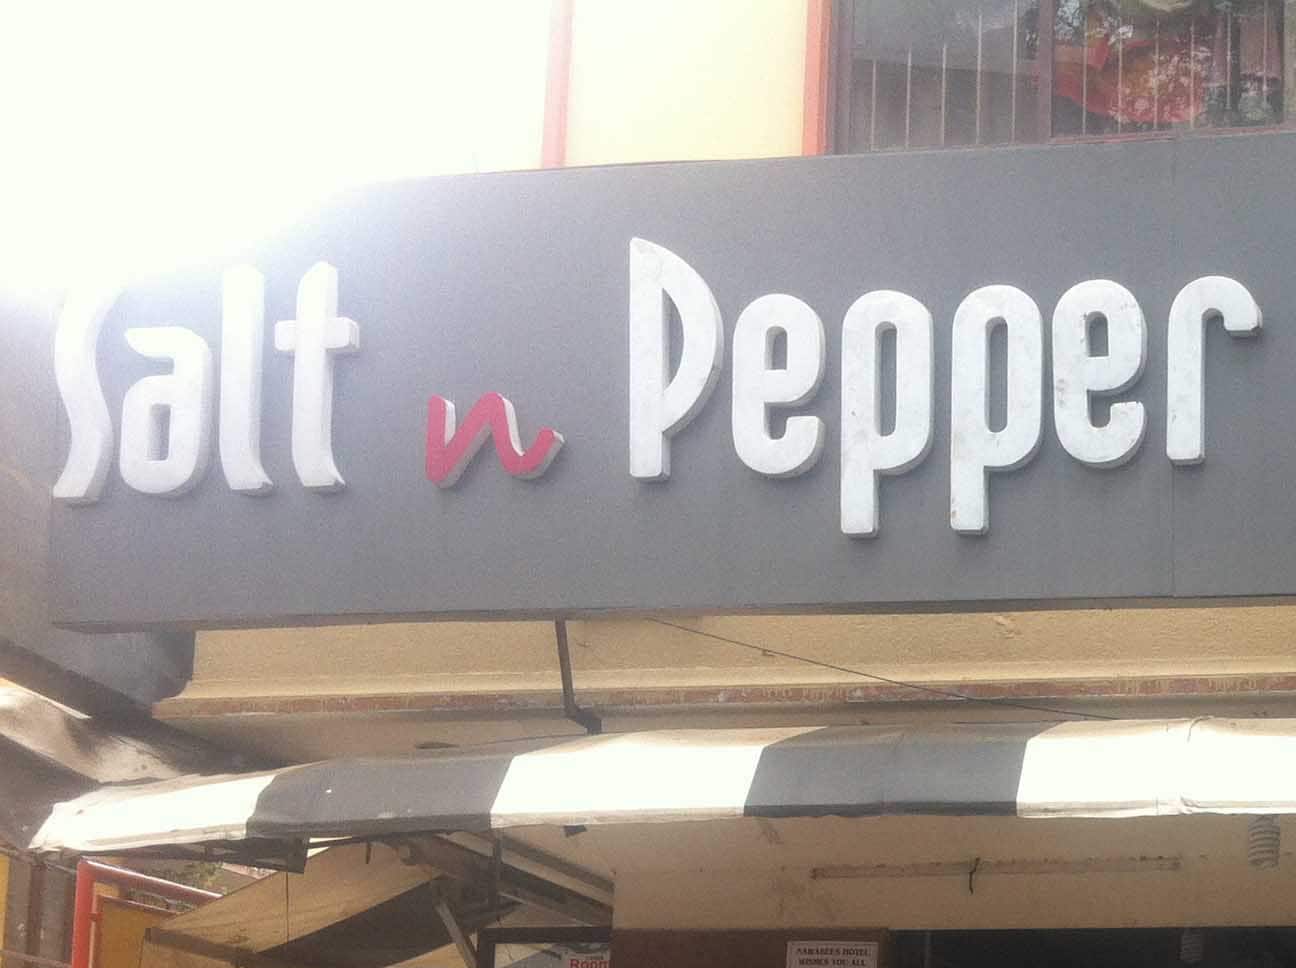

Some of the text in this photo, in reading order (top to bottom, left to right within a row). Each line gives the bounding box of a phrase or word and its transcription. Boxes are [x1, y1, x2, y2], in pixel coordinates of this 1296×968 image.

[53, 236, 1262, 537] Salt n Pepper
